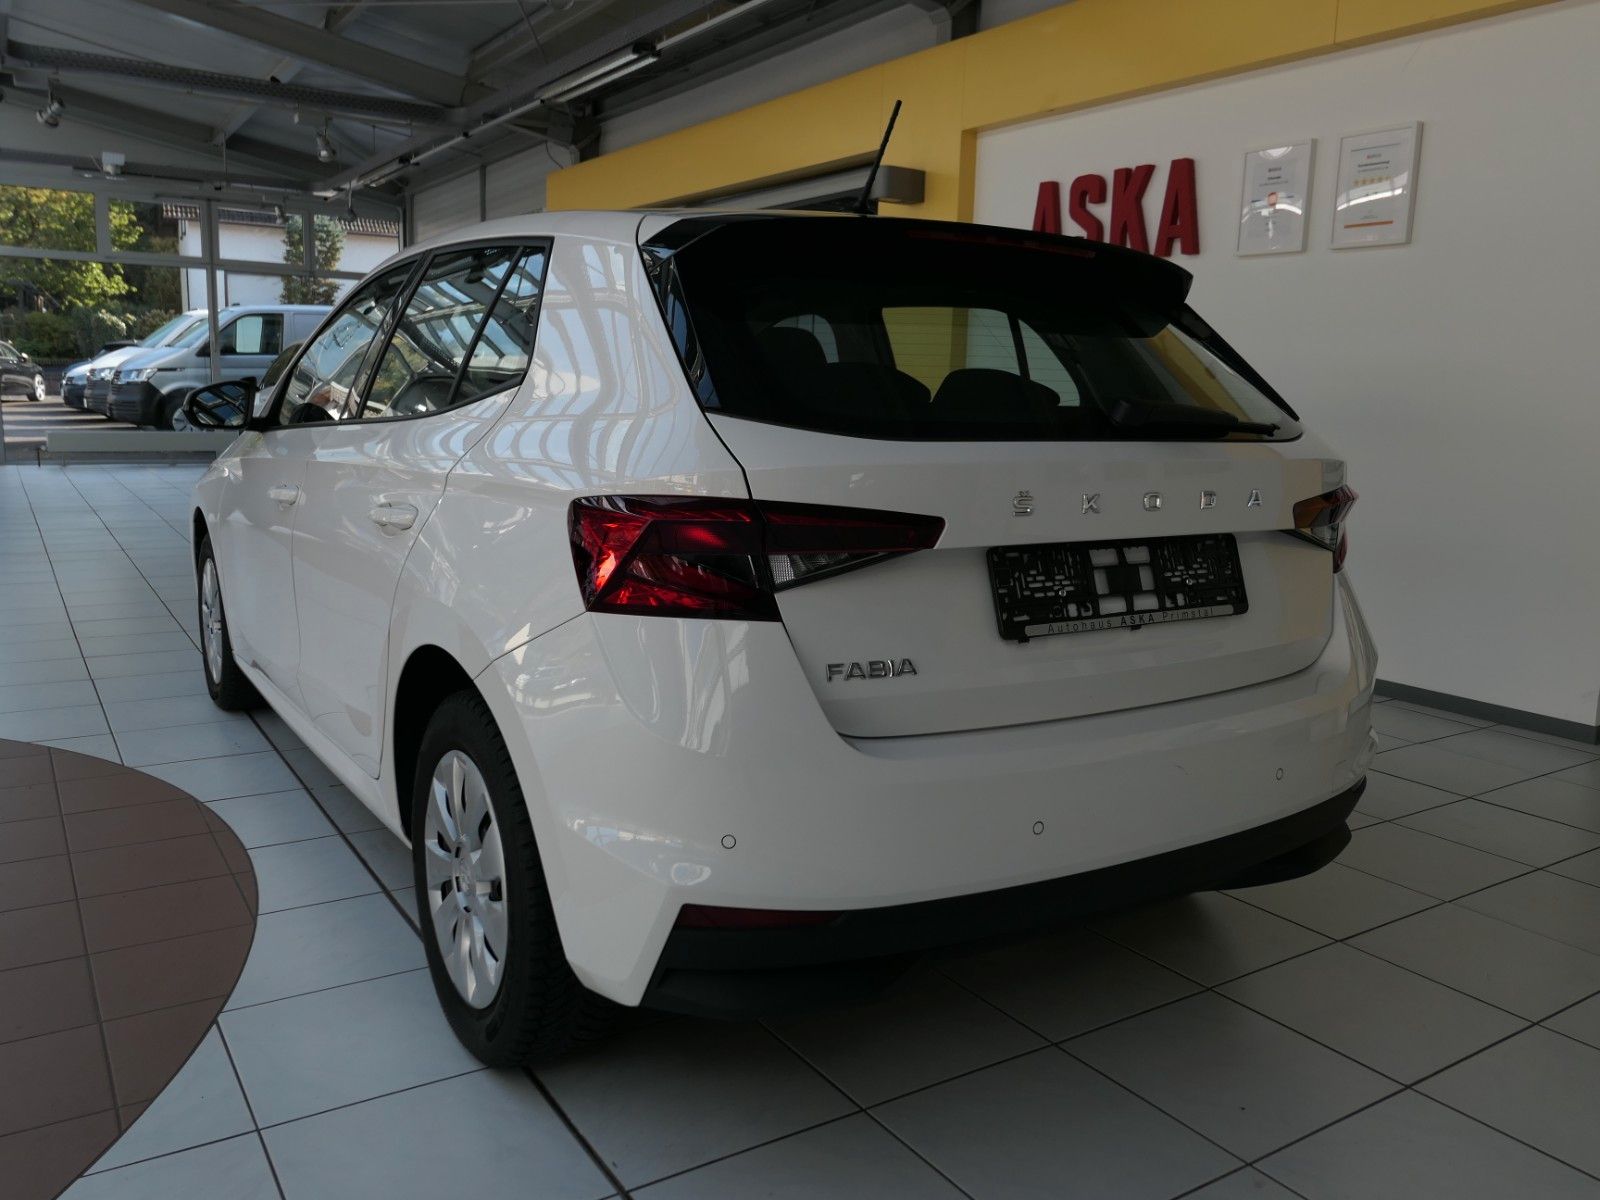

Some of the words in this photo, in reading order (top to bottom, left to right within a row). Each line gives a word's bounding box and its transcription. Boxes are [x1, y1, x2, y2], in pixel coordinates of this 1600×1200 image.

[1033, 158, 1200, 257] ASKA
[1048, 619, 1112, 633] Autohaus
[1120, 613, 1155, 626] ASKA
[1162, 608, 1213, 621] Primstal
[826, 658, 918, 682] FABIA
